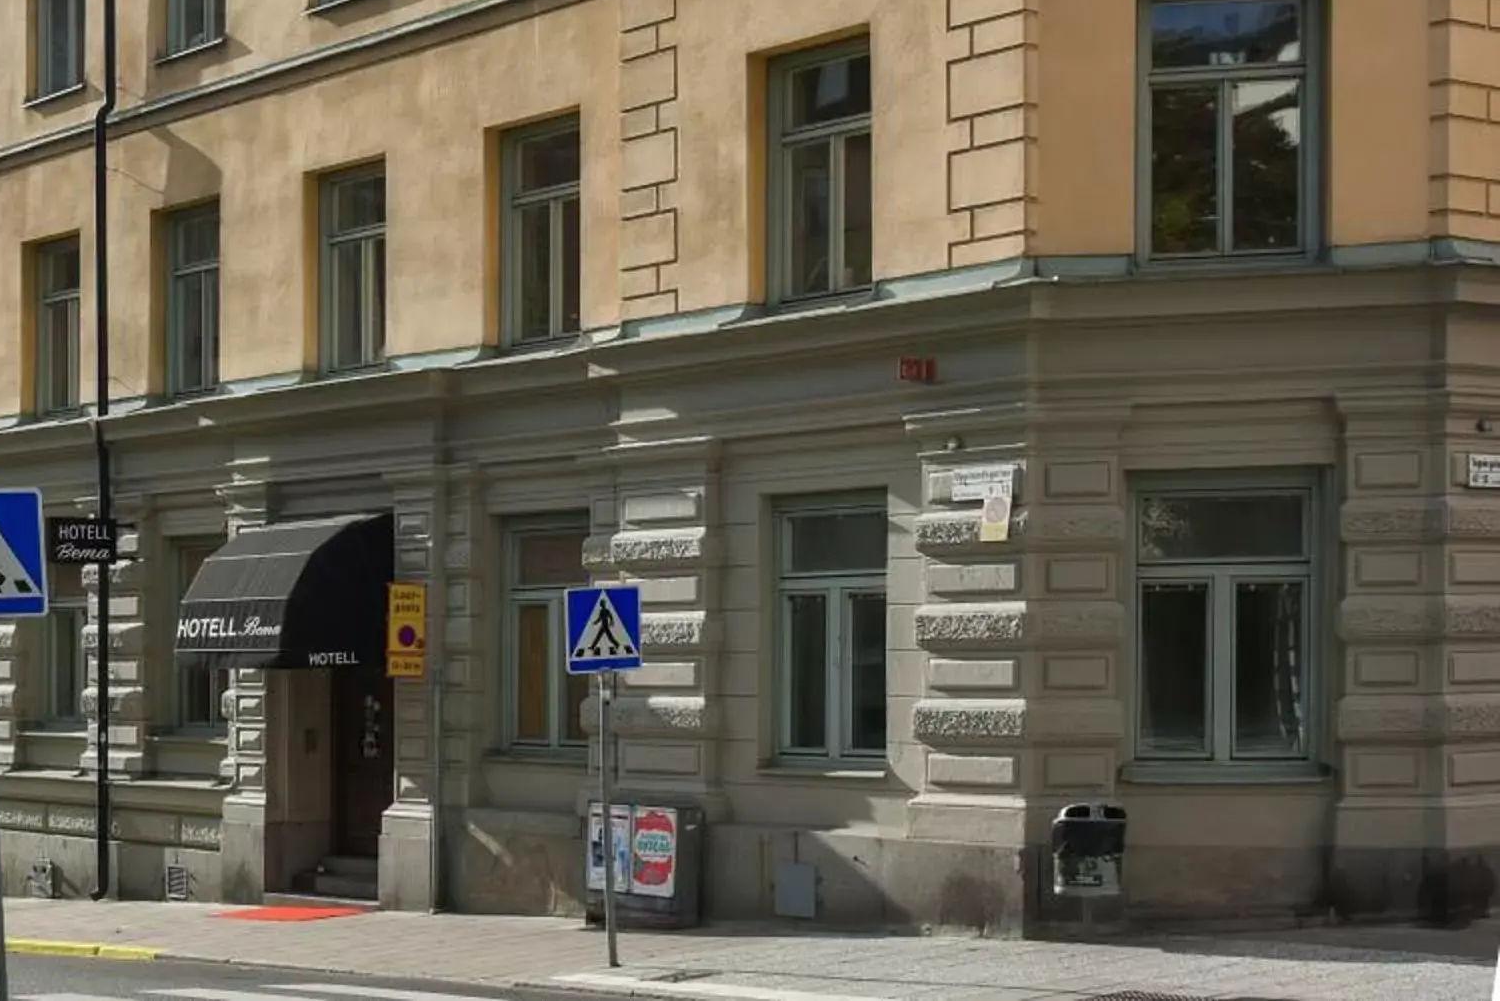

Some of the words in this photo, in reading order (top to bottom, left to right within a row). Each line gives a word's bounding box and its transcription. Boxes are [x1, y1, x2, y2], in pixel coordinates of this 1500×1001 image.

[59, 524, 111, 540] HOTELL
[56, 542, 111, 560] Bema
[176, 616, 236, 638] HOTELL
[308, 650, 360, 666] HOTELL
